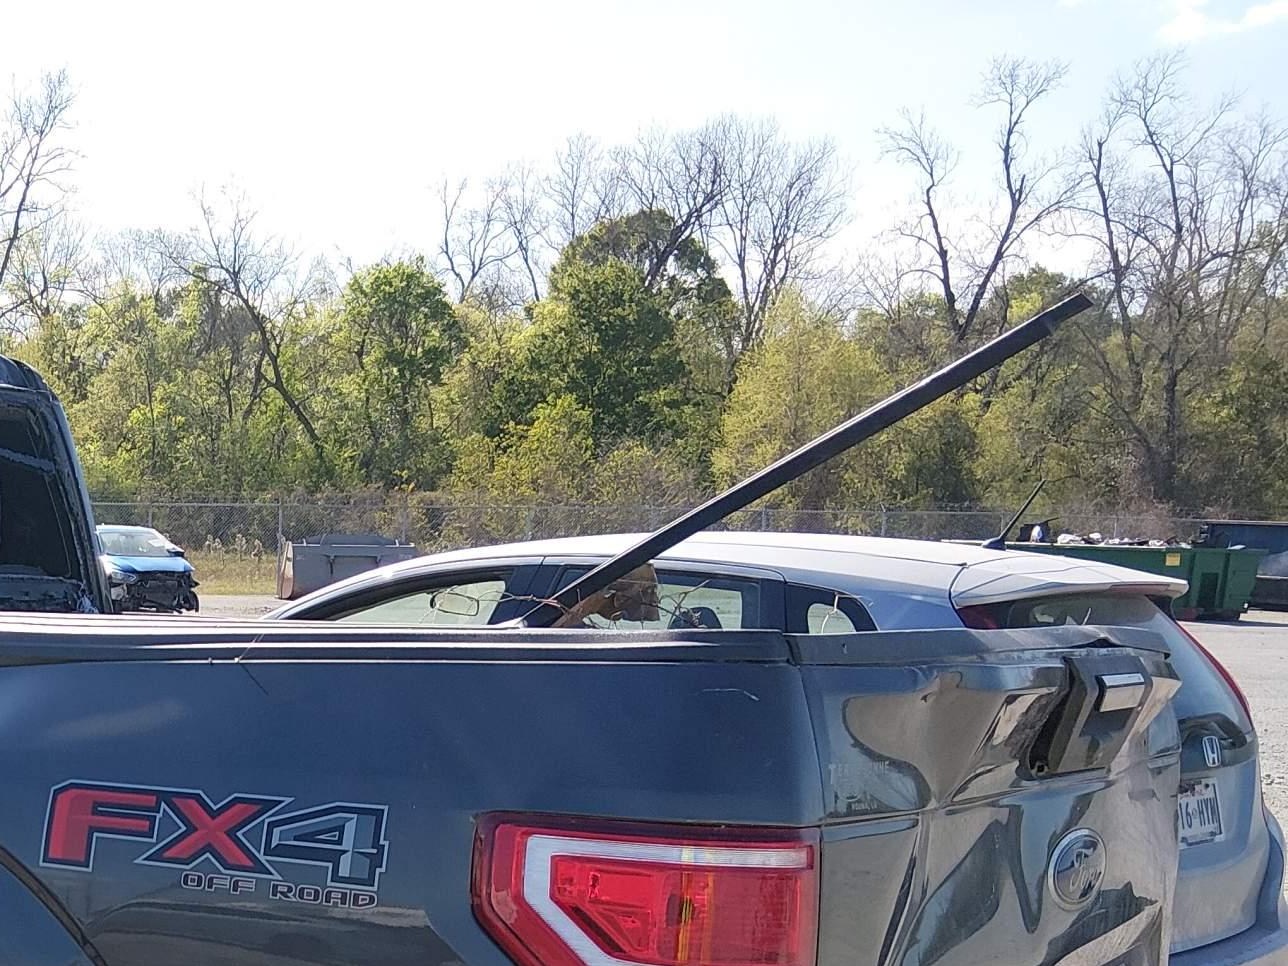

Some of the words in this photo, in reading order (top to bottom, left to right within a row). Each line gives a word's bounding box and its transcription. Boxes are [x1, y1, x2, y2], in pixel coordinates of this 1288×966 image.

[40, 780, 388, 889] FX4
[181, 872, 255, 895] OFF
[269, 881, 377, 909] ROAD
